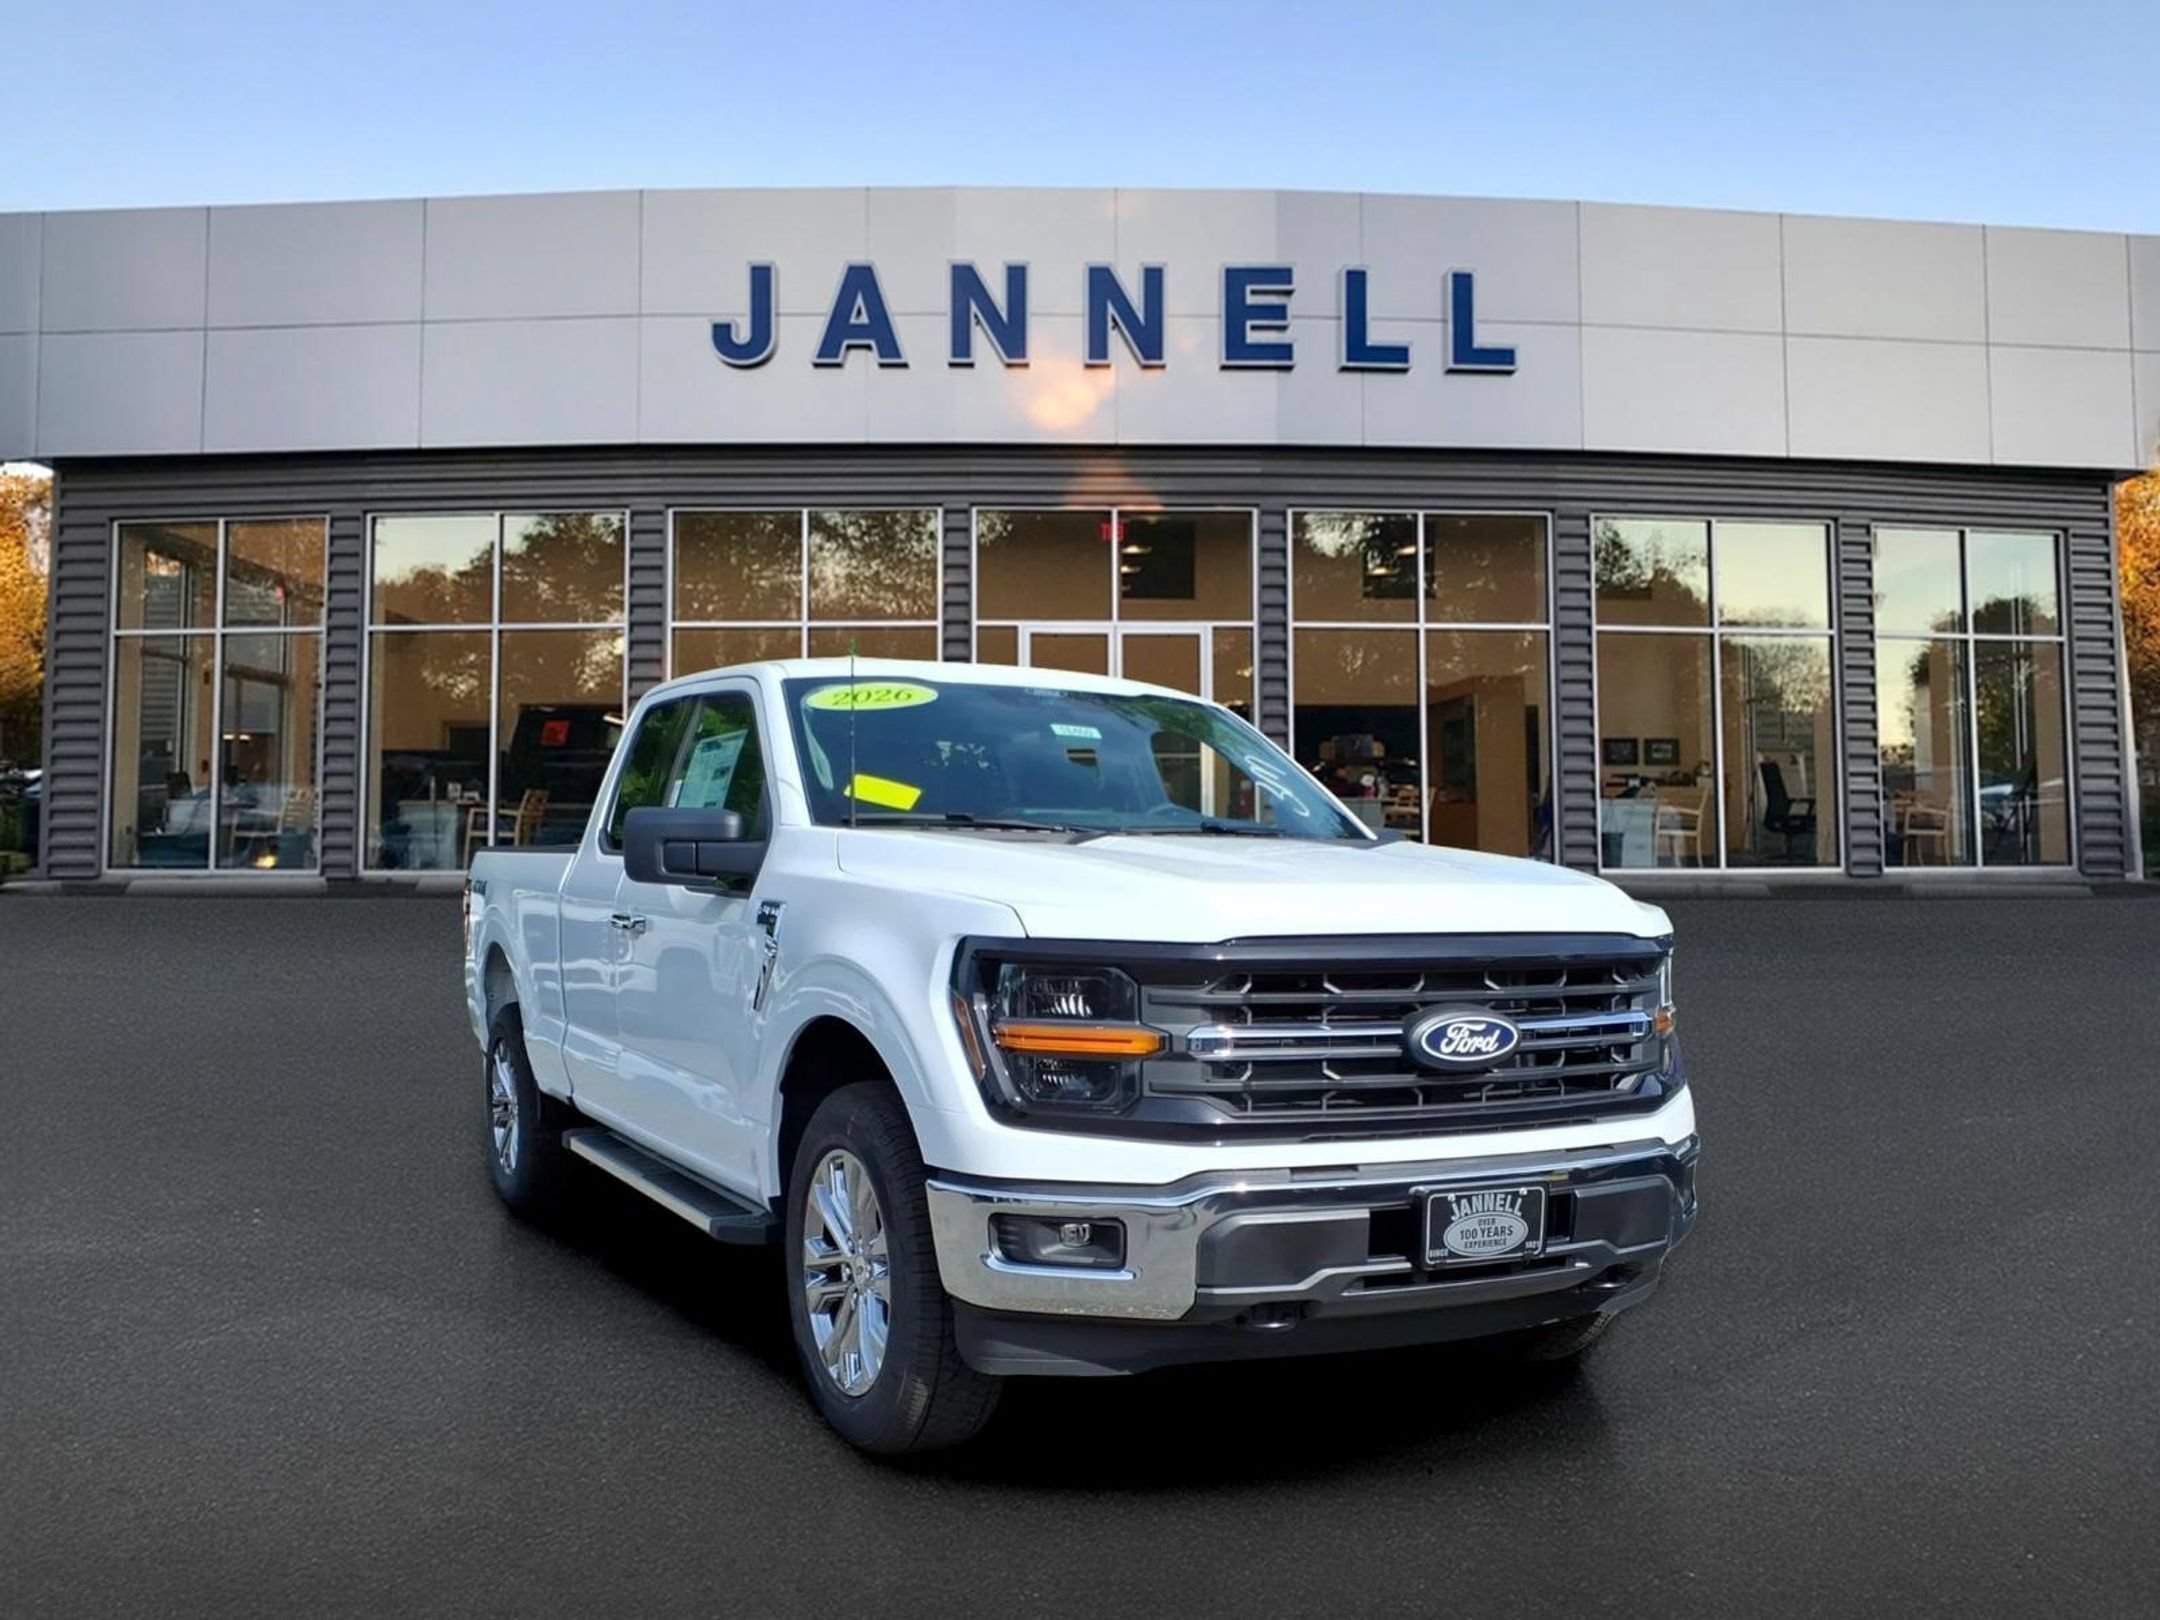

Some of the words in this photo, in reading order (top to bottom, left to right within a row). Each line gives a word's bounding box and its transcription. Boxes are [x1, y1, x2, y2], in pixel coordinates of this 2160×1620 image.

[711, 261, 1517, 372] JANNELL
[832, 687, 913, 706] 2026
[1440, 1022, 1500, 1053] Ford
[1450, 1193, 1522, 1221] JANNELL
[1460, 1228, 1478, 1240] 100
[1480, 1225, 1513, 1238] YEARS
[1478, 1218, 1496, 1226] OVER
